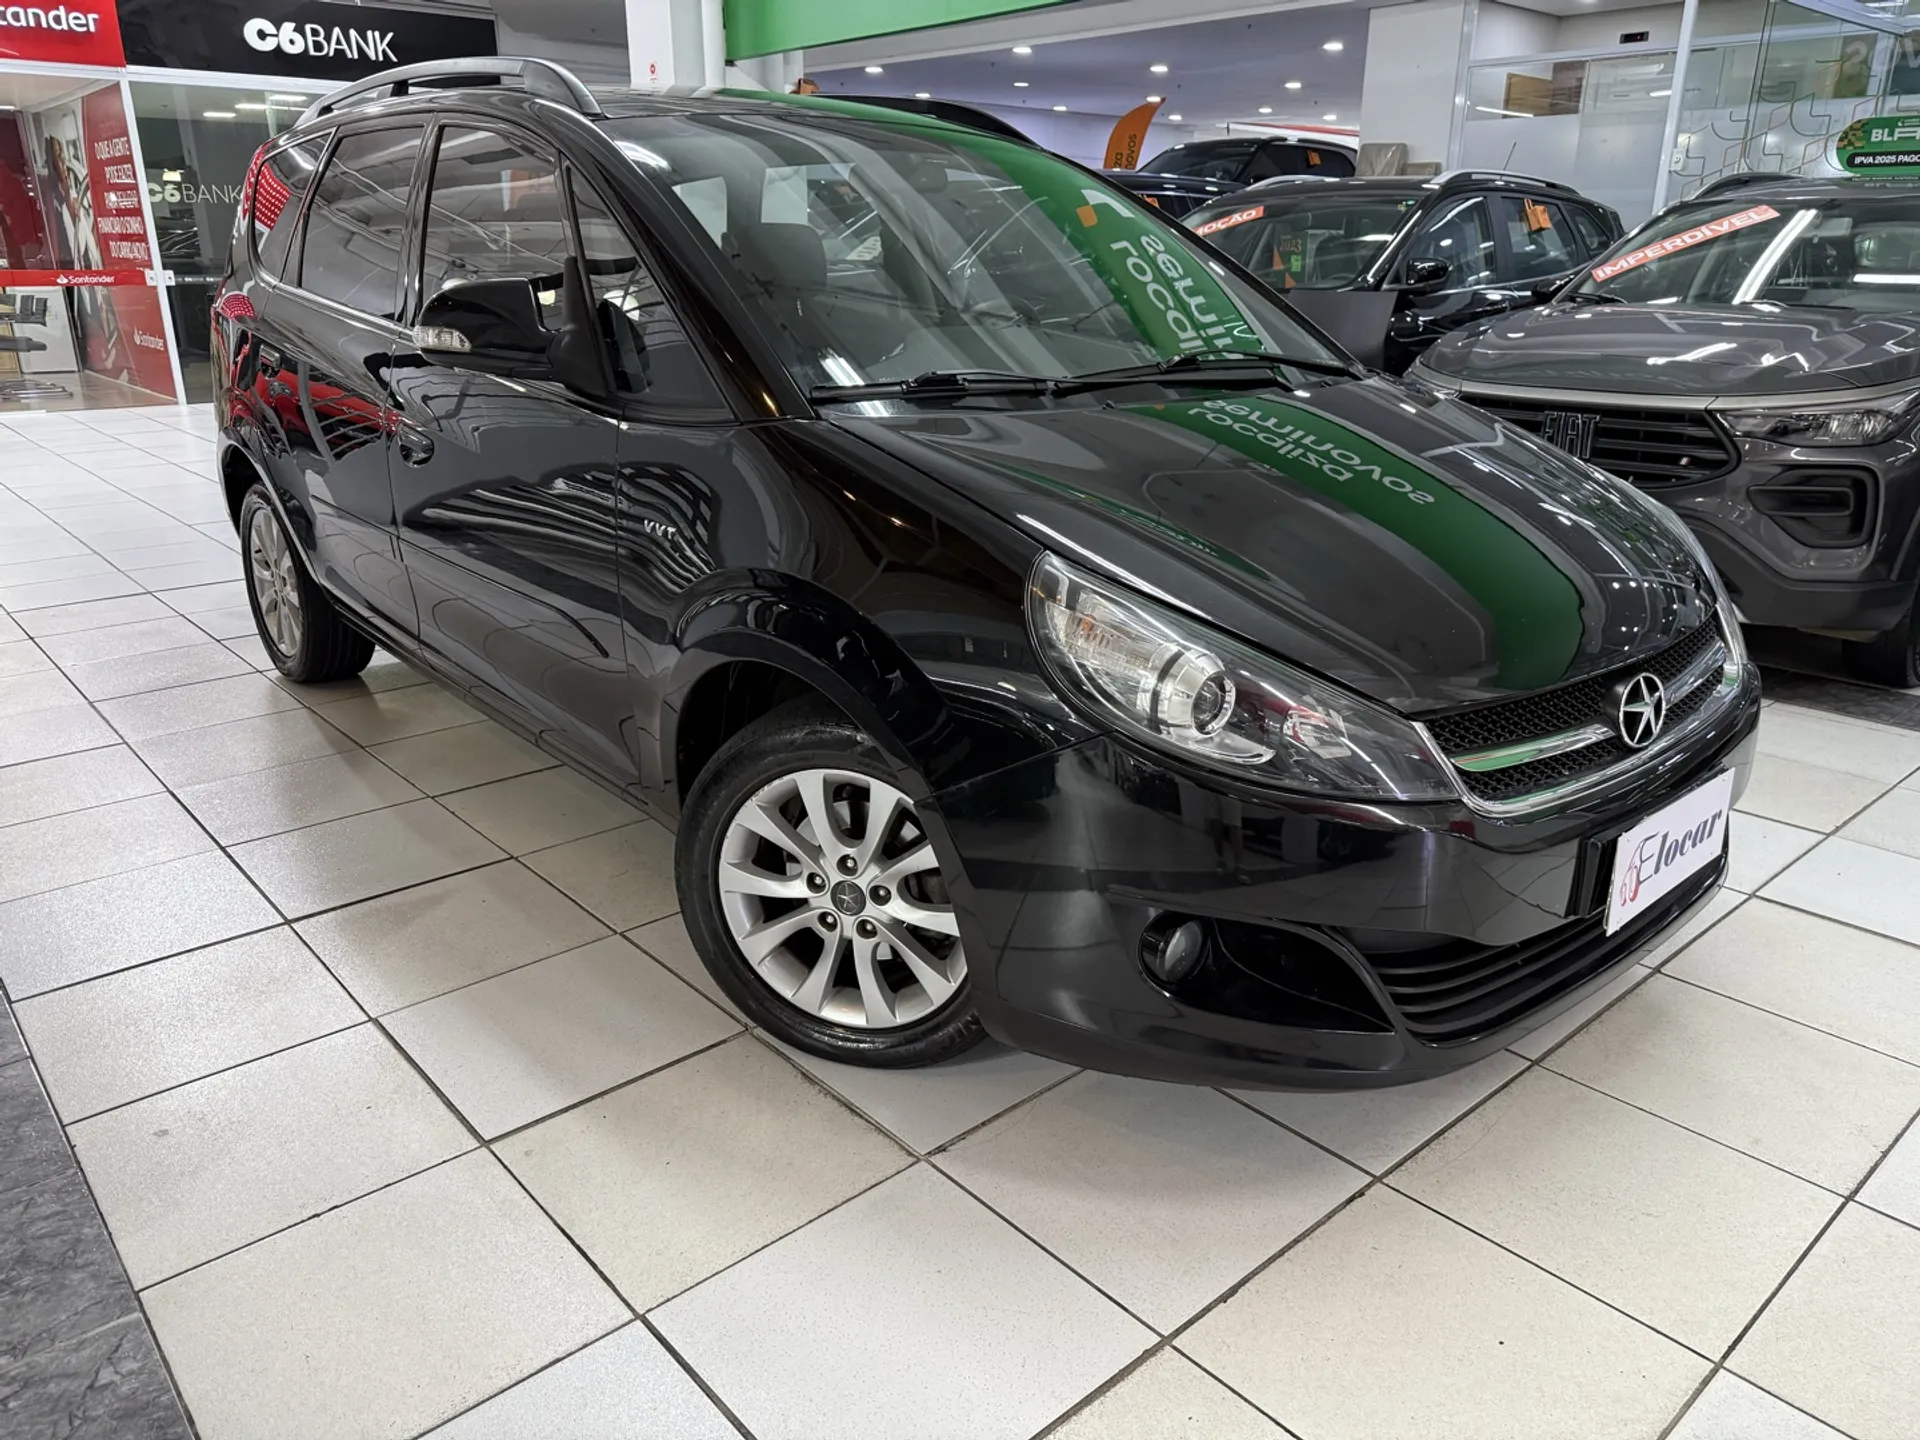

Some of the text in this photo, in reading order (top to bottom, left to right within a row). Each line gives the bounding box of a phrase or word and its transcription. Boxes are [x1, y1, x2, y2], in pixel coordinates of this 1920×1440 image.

[1854, 155, 1873, 164] IPVA
[1874, 154, 1897, 164] 2025
[68, 275, 116, 285] Santander
[1543, 411, 1601, 459] FIAT
[644, 519, 677, 540] VVT
